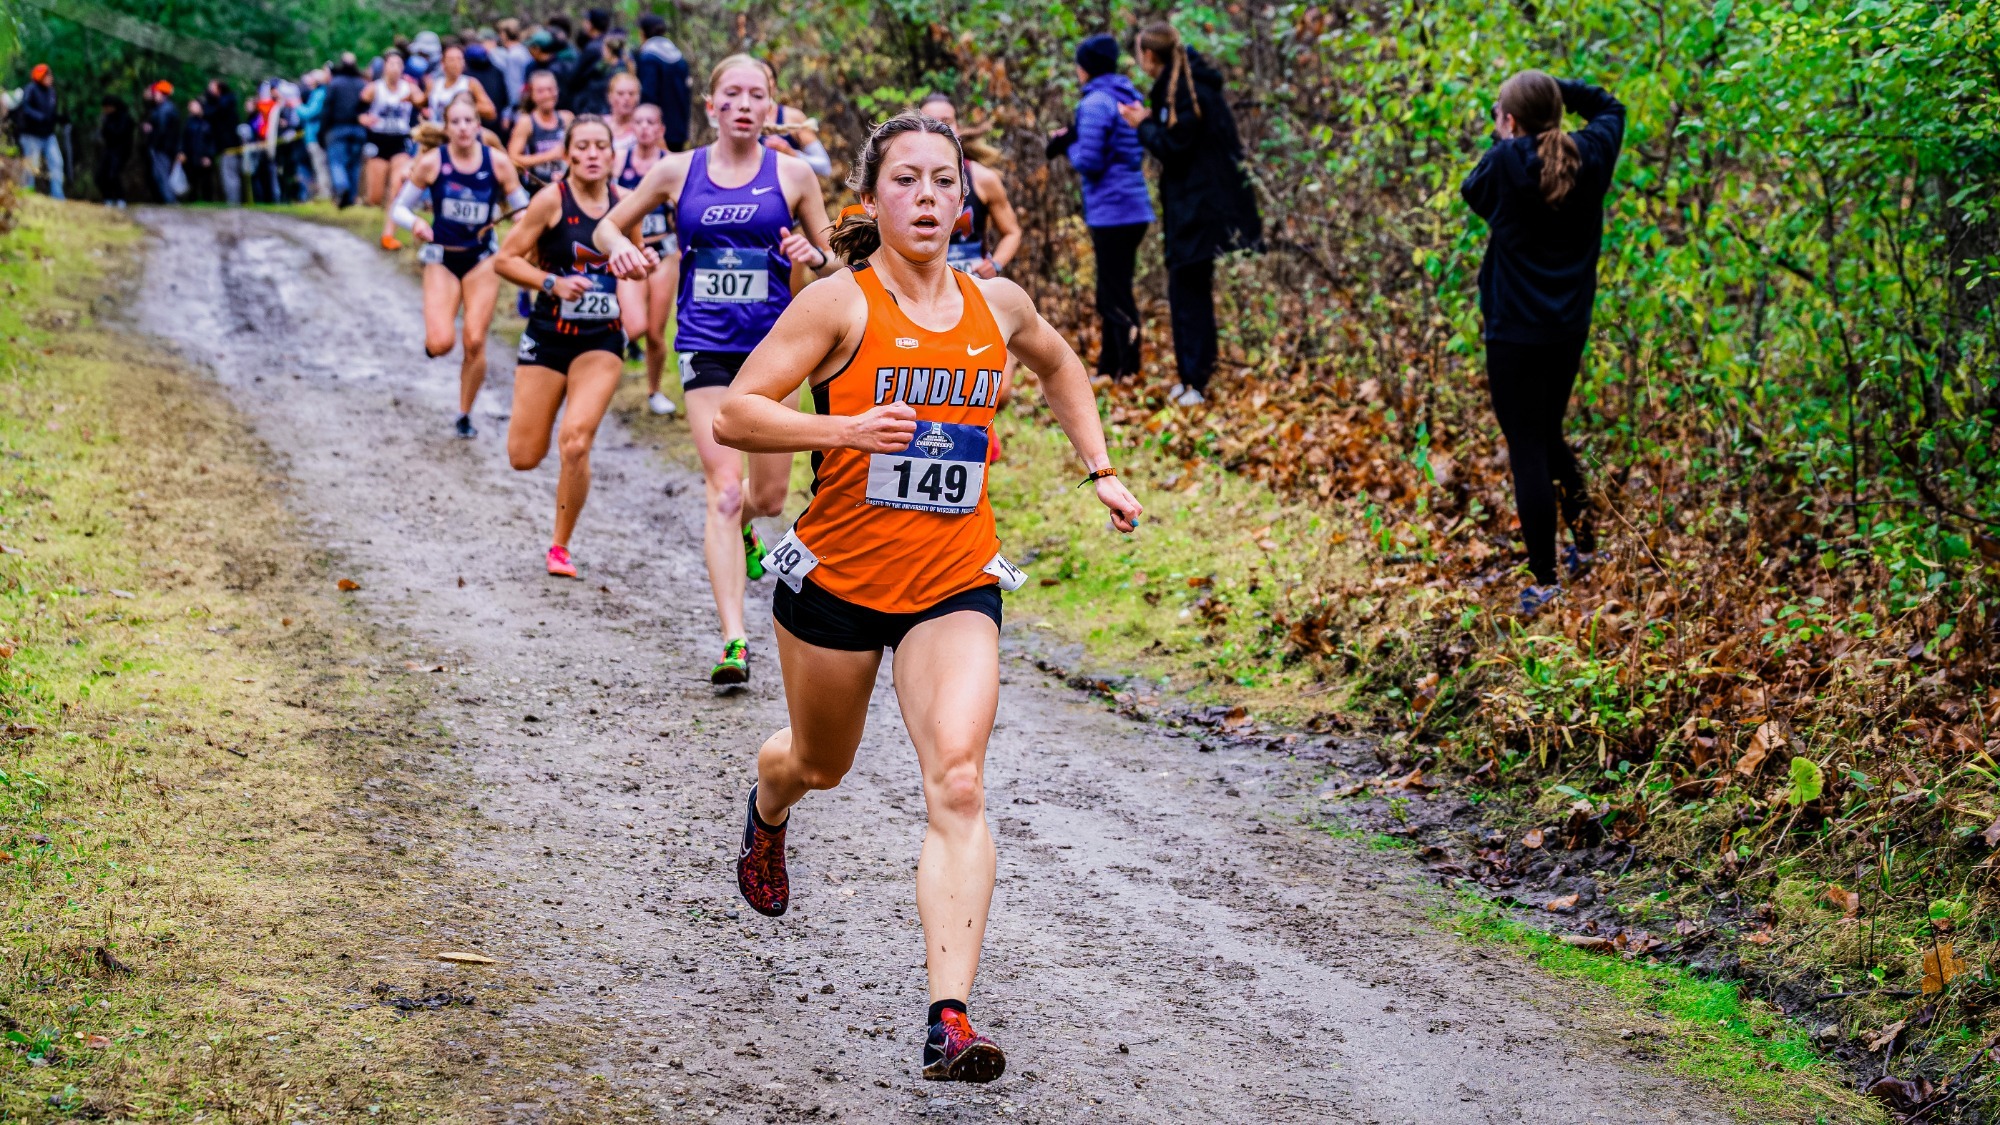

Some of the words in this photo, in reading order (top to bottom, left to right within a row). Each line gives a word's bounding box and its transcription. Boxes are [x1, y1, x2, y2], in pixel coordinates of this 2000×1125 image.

[453, 201, 479, 219] 301
[701, 204, 759, 225] SBU
[706, 273, 754, 296] 307
[573, 295, 610, 315] 228
[874, 367, 1002, 408] FINDLAY
[893, 460, 967, 503] 149
[771, 537, 801, 576] 49
